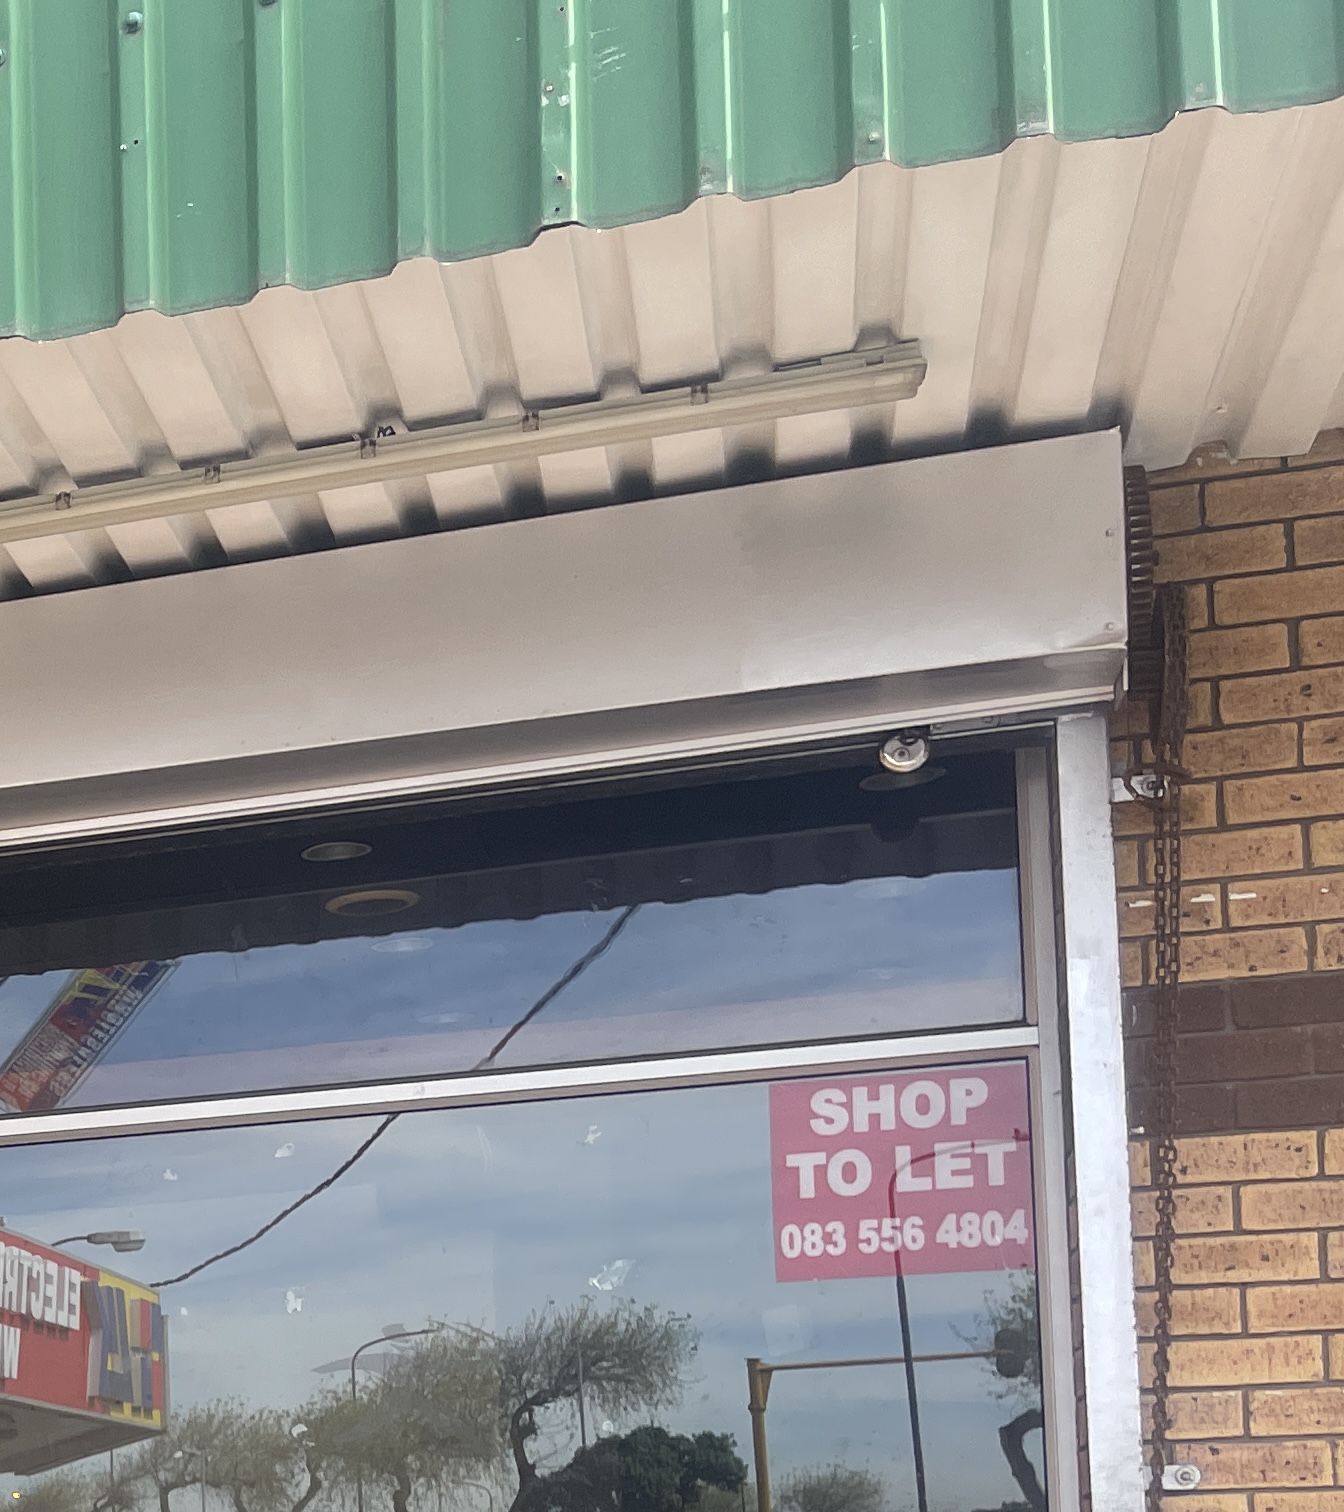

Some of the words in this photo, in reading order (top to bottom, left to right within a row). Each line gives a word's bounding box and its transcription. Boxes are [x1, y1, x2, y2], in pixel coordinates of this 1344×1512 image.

[809, 1077, 989, 1136] SHOP
[785, 1148, 873, 1199] TO
[894, 1140, 1017, 1192] LET
[780, 1220, 847, 1259] 083
[857, 1215, 925, 1254] 556
[935, 1208, 1029, 1249] 4804
